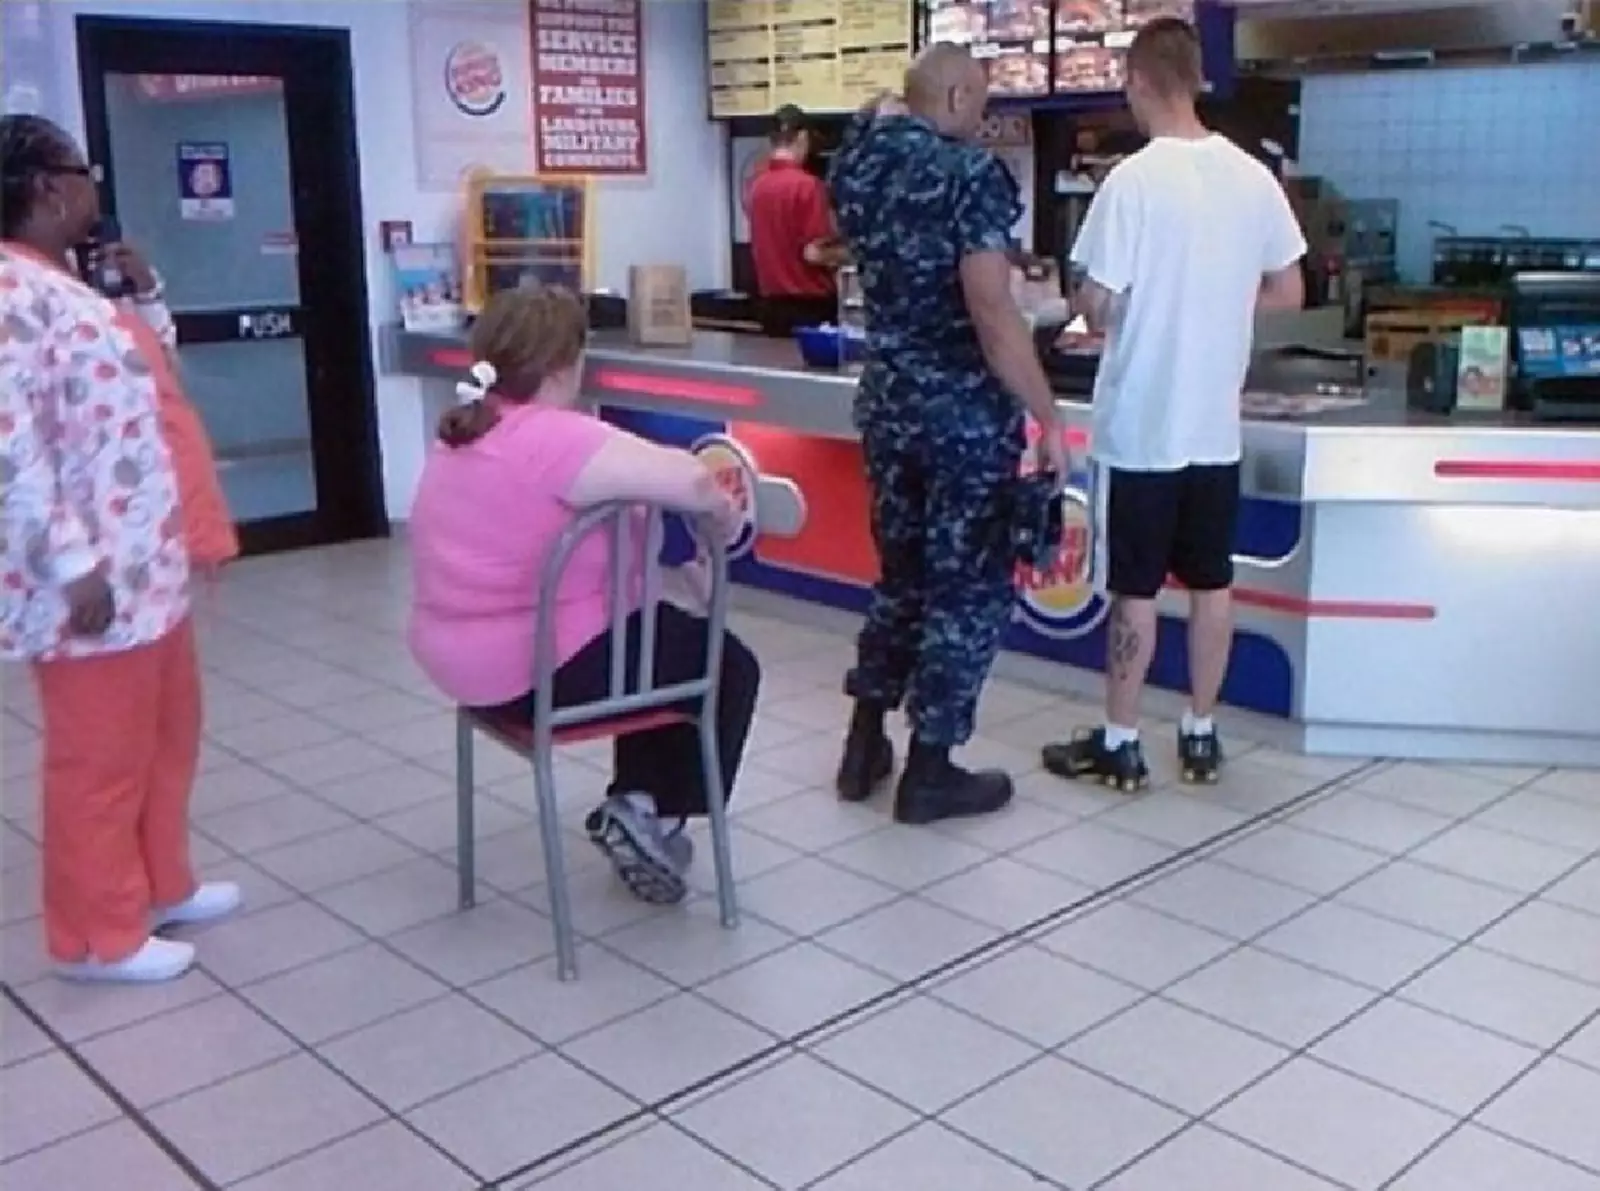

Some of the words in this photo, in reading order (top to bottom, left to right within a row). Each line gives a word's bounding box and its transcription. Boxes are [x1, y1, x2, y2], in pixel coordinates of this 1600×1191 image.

[539, 30, 636, 54] SERVICE
[539, 54, 636, 75] MEMBERS
[540, 85, 637, 106] FAMILIES
[543, 134, 638, 151] MILITARY
[239, 312, 290, 337] PUSH
